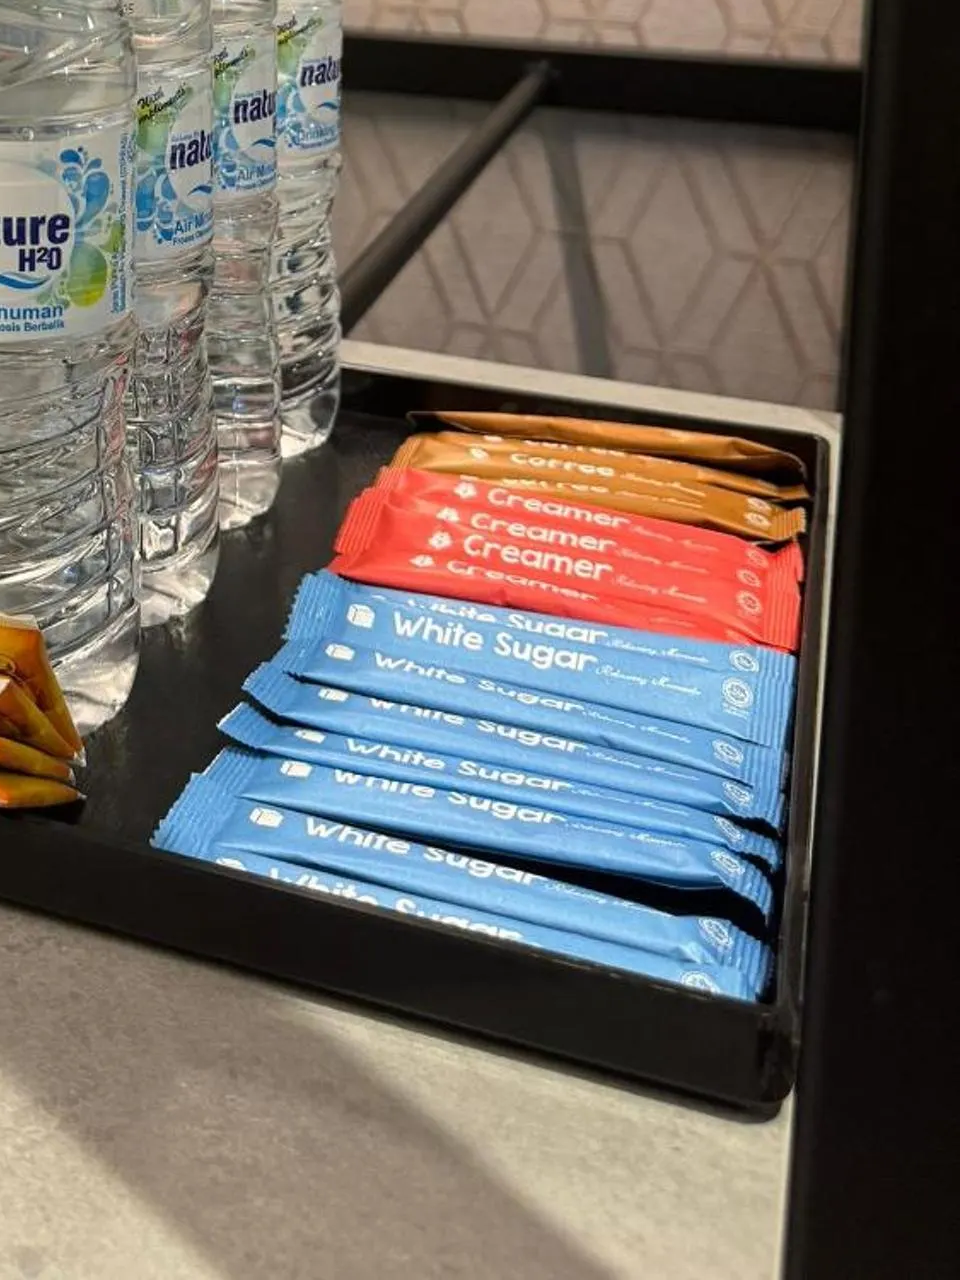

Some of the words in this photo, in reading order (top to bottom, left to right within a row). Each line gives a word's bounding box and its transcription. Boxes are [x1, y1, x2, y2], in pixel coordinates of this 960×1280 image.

[487, 487, 630, 528] Creamer
[470, 512, 618, 553] Creamer
[463, 533, 614, 581] Creamer
[446, 560, 599, 601] Creamer
[393, 610, 485, 652] White
[493, 631, 599, 672] Sugar
[374, 651, 467, 685] White
[477, 679, 585, 713] Sugar
[476, 718, 590, 754] Sugar
[346, 737, 446, 770] White
[457, 760, 574, 792] Sugar
[447, 790, 568, 824] Sugar
[305, 816, 412, 855] White
[423, 845, 548, 887] Sugar
